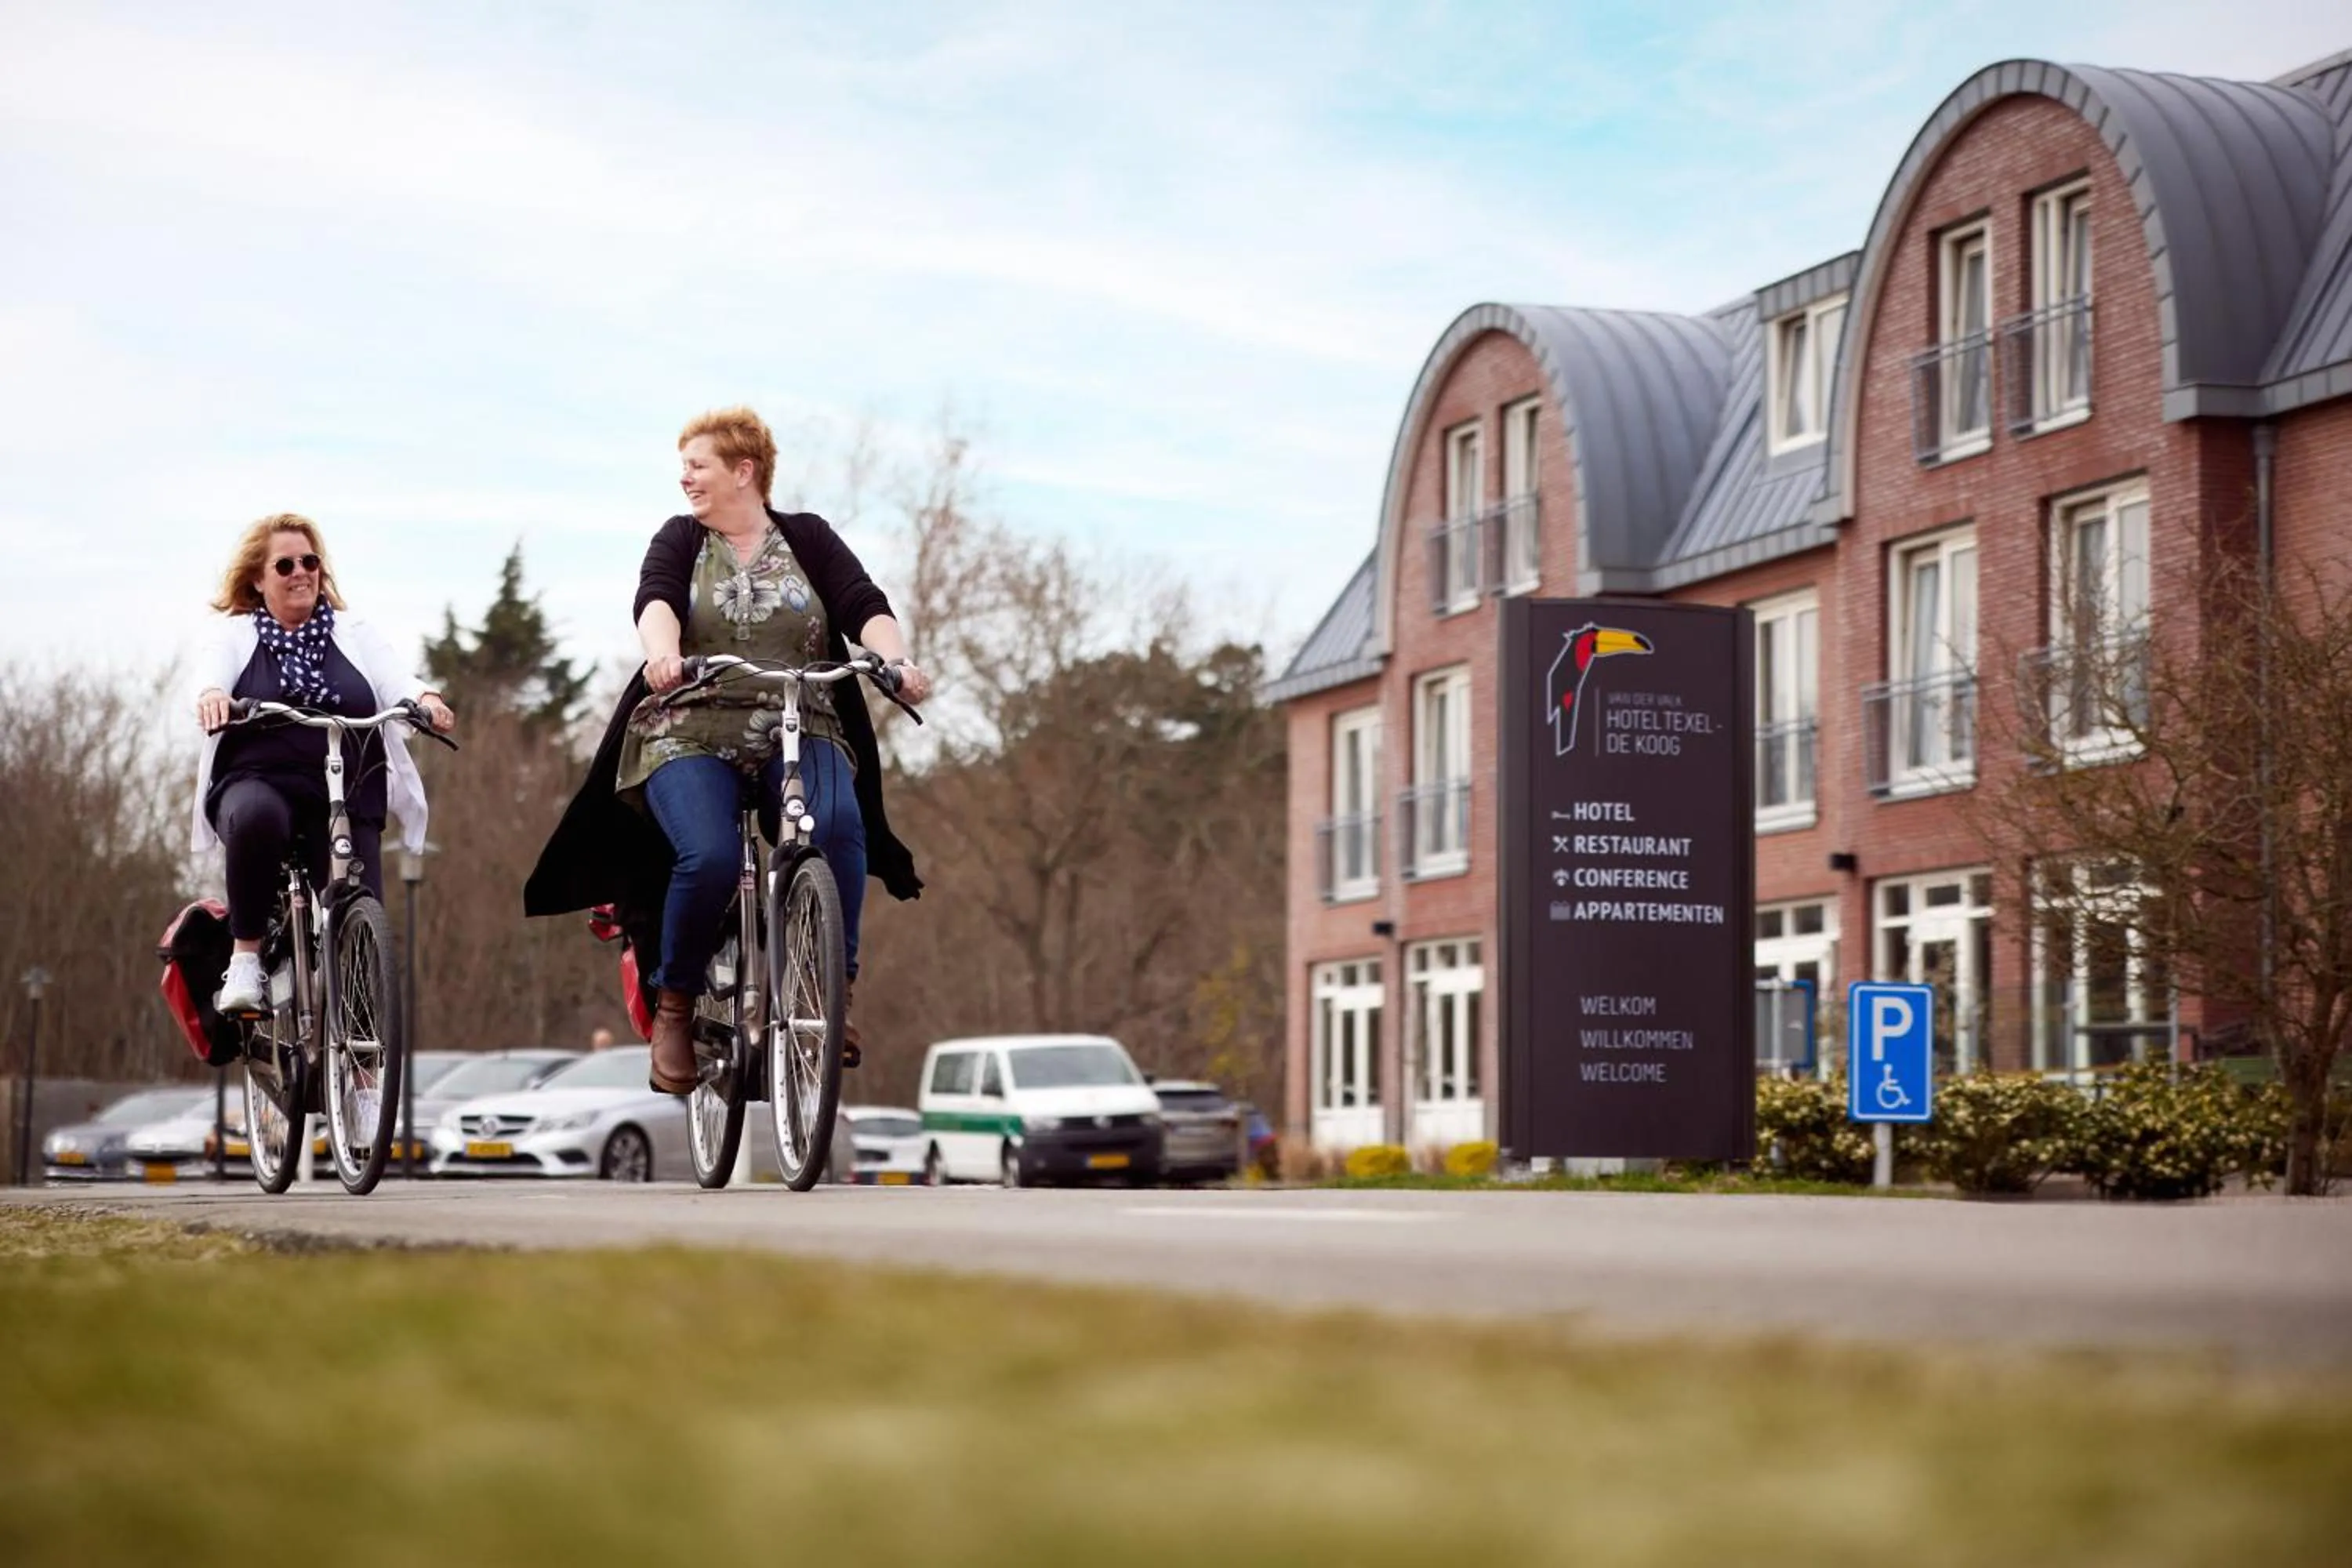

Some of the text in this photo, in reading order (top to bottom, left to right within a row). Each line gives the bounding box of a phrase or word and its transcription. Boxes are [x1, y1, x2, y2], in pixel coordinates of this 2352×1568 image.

[1606, 710, 1661, 731] HOTEL
[1606, 733, 1681, 755] DE KOOG
[1573, 802, 1635, 822] HOTEL
[1573, 835, 1692, 856] RESTAURANT
[1573, 868, 1690, 889] CONFERENCE
[1573, 901, 1724, 924] APPARTEMENTEN
[1580, 996, 1656, 1015] WELKOM
[1580, 1029, 1693, 1049] WILLKOMMEN
[1871, 996, 1914, 1061] P
[1580, 1062, 1667, 1083] WELCOME
